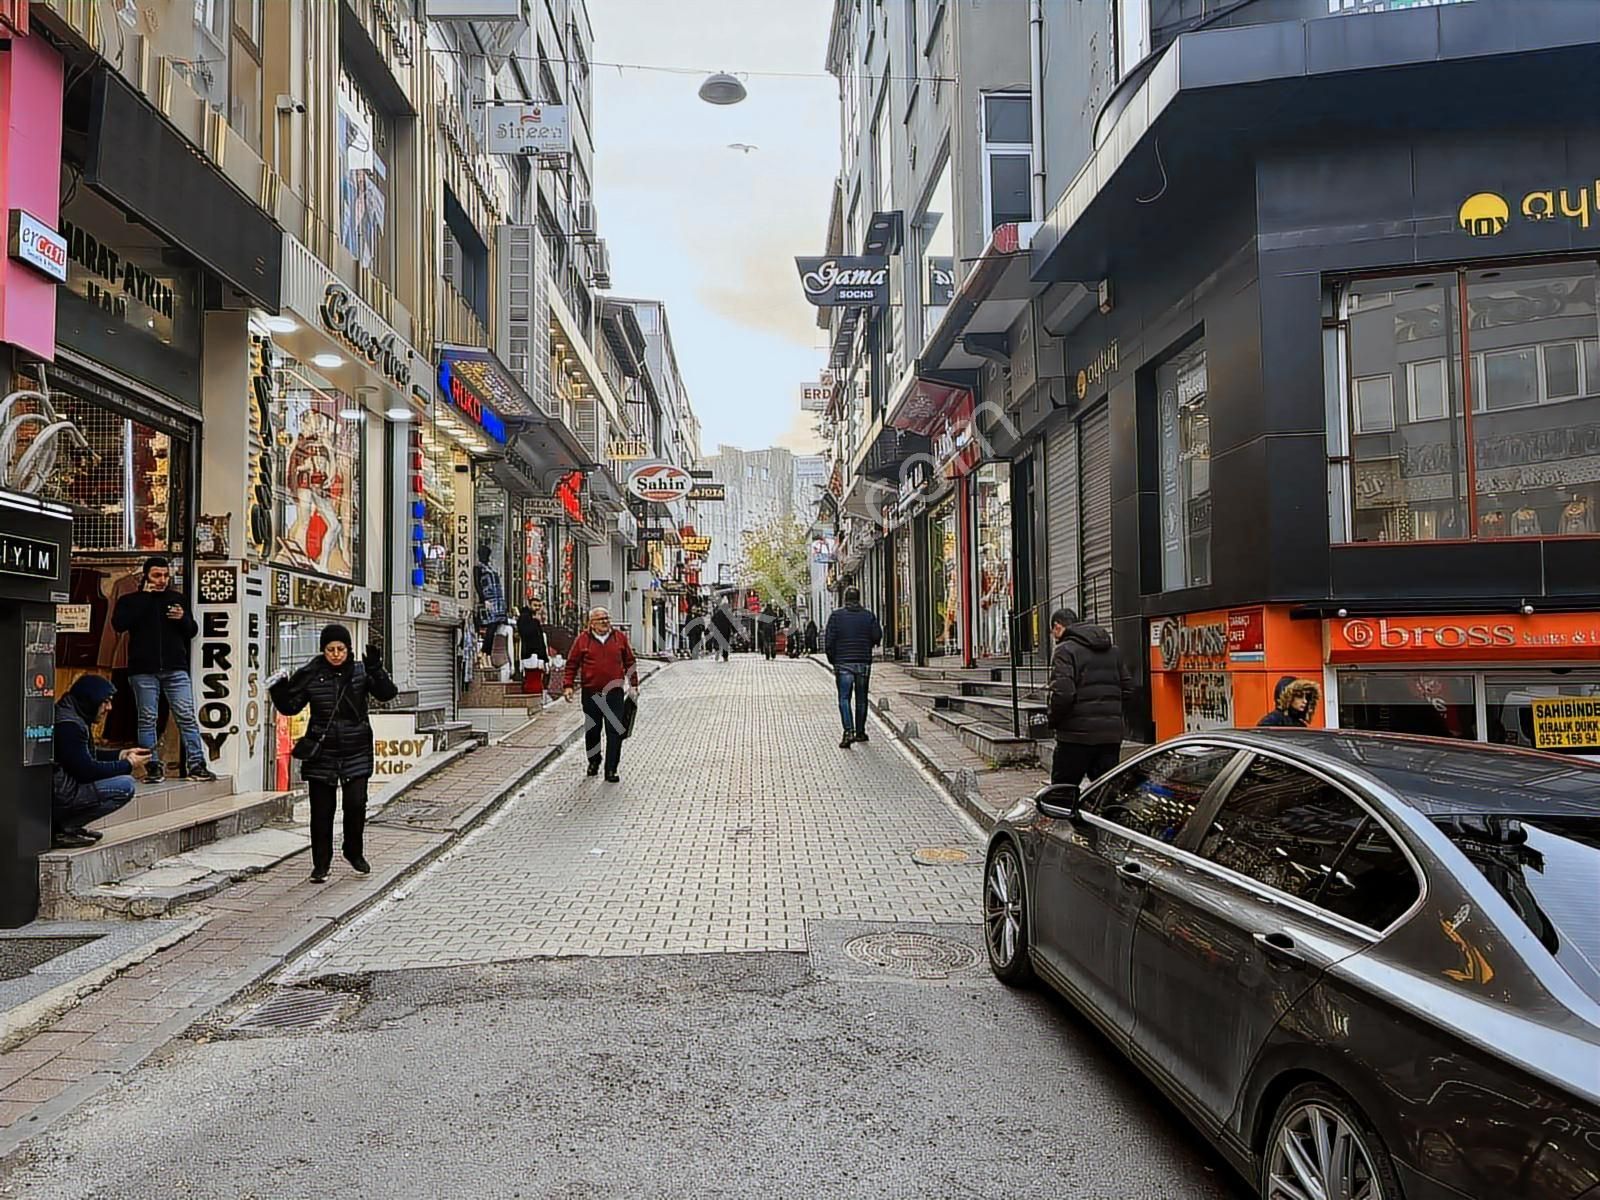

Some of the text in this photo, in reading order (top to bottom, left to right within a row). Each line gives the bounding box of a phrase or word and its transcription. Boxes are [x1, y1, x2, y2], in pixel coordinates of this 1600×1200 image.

[22, 227, 65, 267] ercan
[803, 260, 887, 294] Gama
[840, 290, 873, 299] SOCKS
[636, 476, 685, 493] Şahin
[458, 515, 469, 555] RUKO
[0, 540, 49, 570] İYİM
[1377, 617, 1516, 648] bross
[199, 612, 233, 762] ERSOY
[246, 613, 260, 758] ERSOY
[374, 739, 426, 758] RSOY
